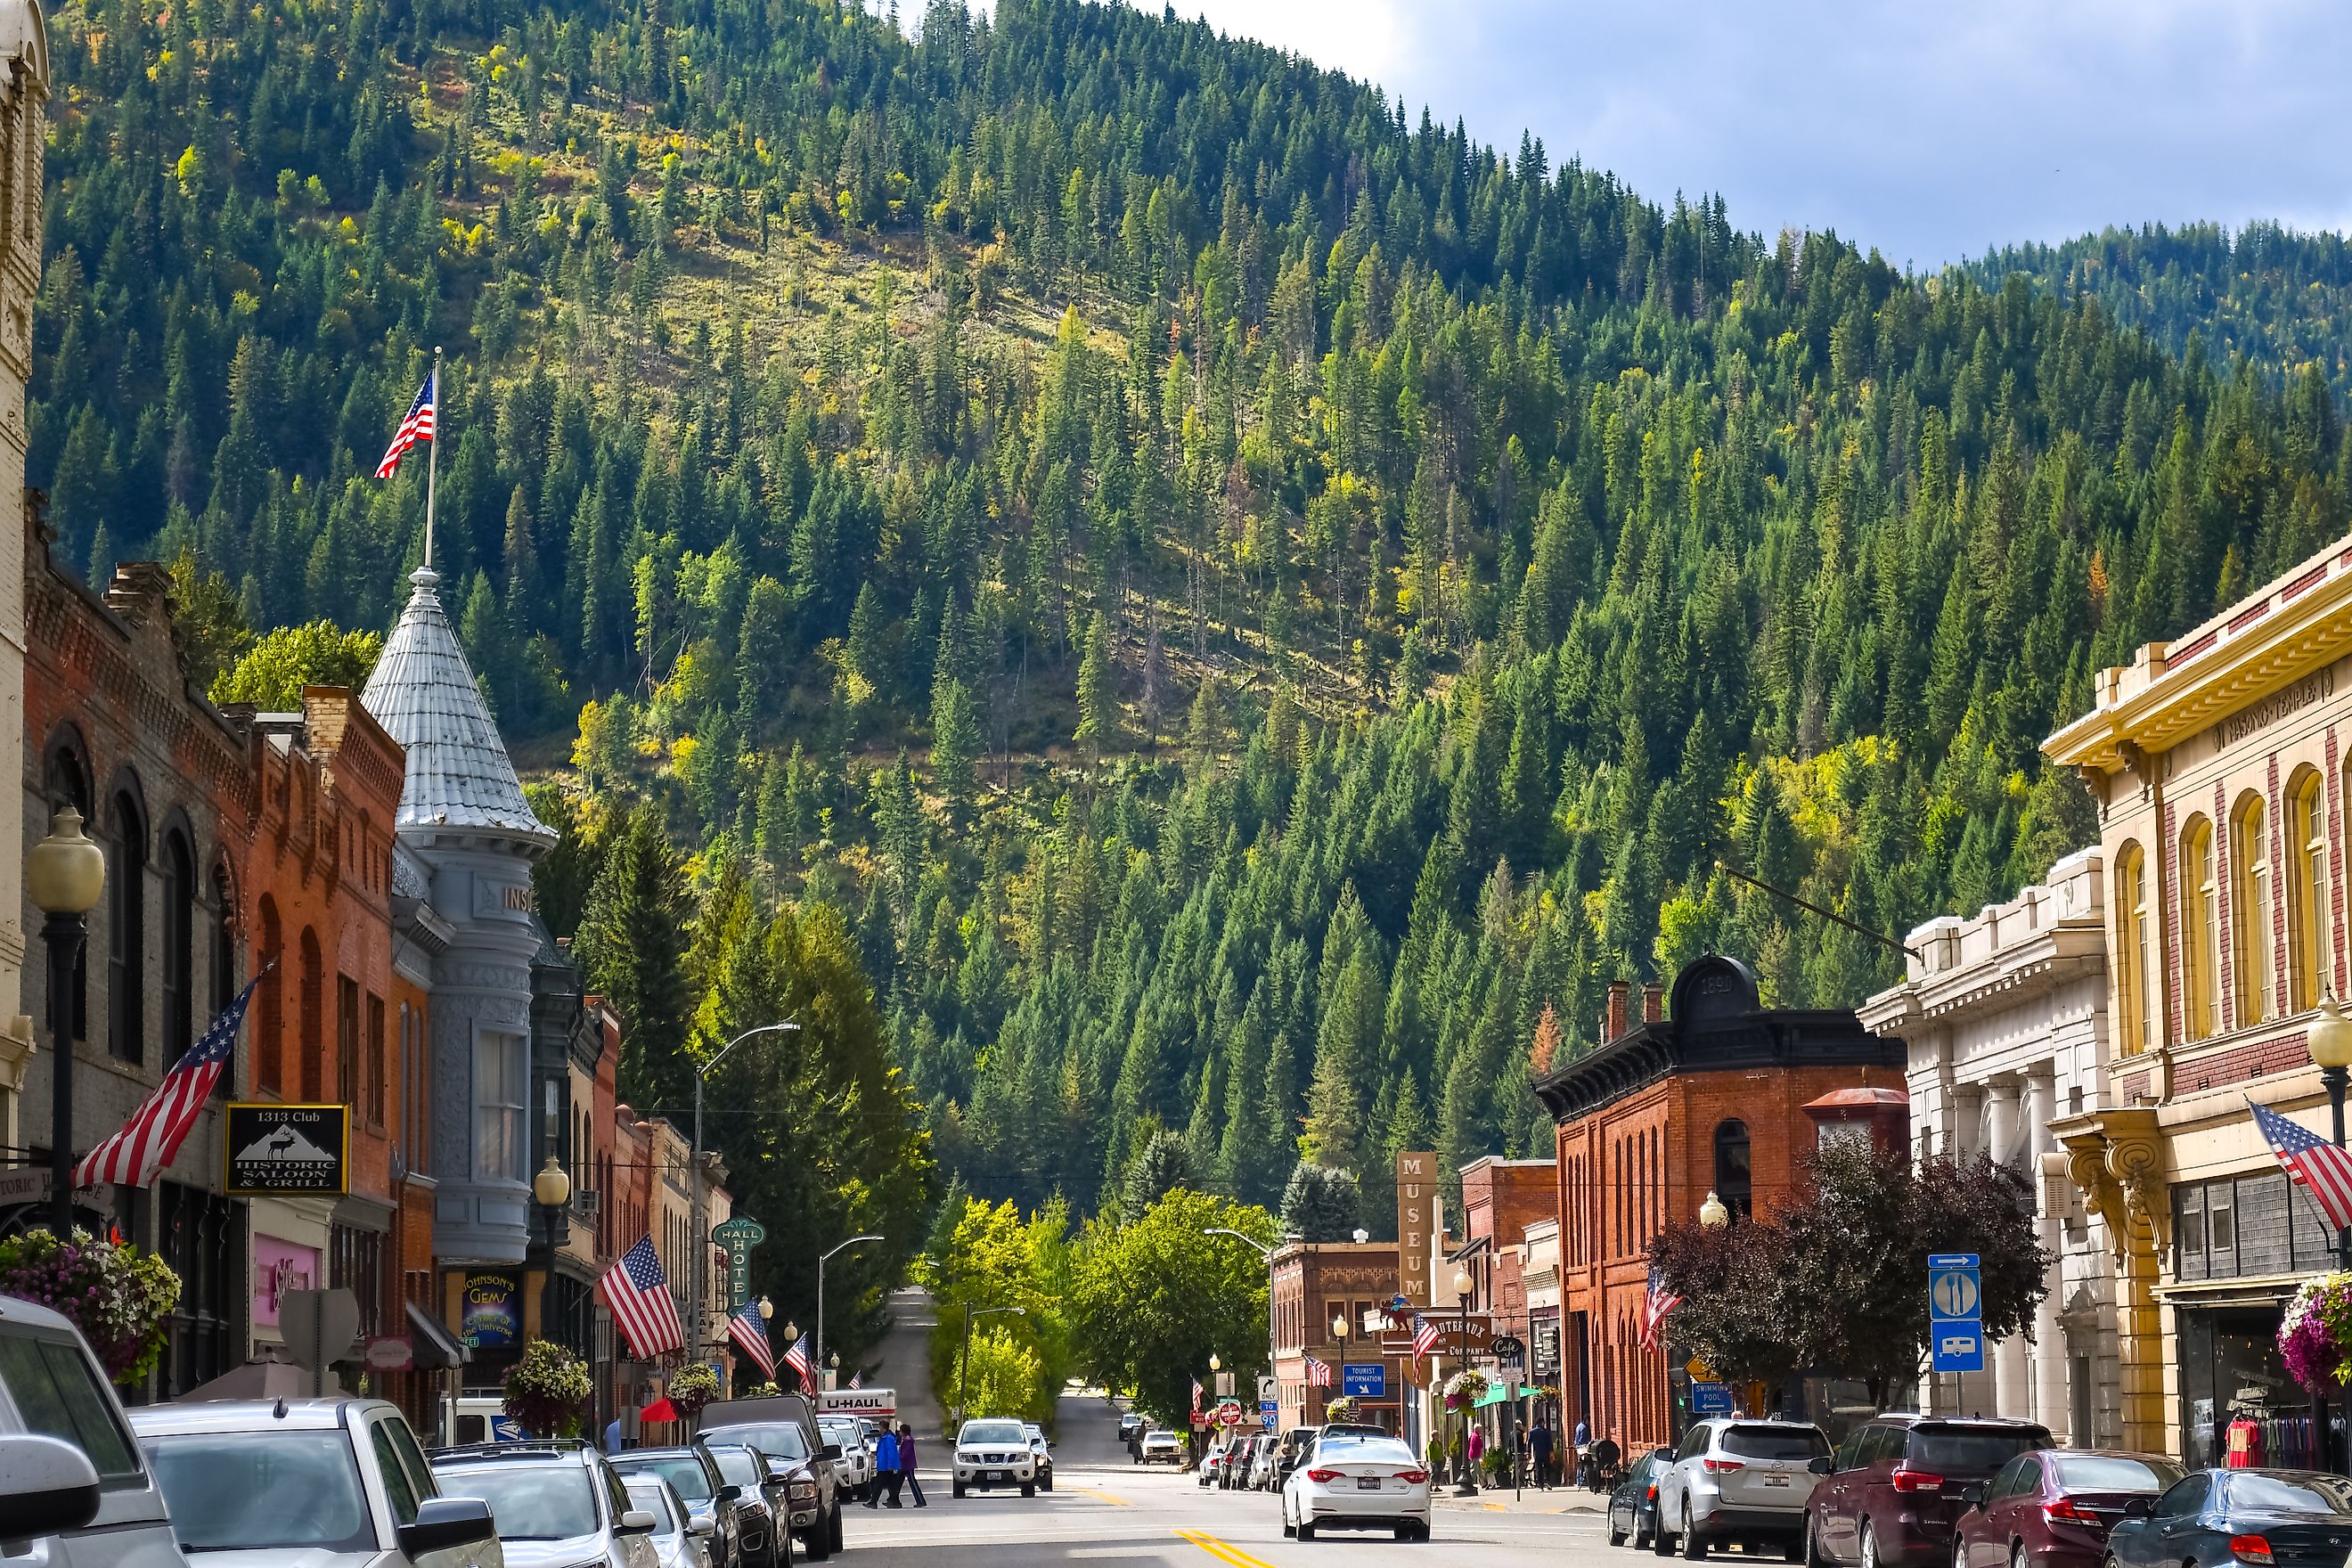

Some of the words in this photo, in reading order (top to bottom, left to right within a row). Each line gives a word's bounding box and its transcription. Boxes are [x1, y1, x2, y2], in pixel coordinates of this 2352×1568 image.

[2229, 706, 2269, 743] MASONIC
[2274, 684, 2315, 720] TEMPLE
[257, 1112, 289, 1123] 1313
[292, 1112, 320, 1123] Club
[236, 1162, 336, 1170] HISTORIC
[242, 1171, 327, 1179] SALOON
[1402, 1159, 1425, 1295] MUSEUM
[733, 1240, 746, 1306] HOTEL
[463, 1276, 515, 1292] JOHNSON'S
[698, 1302, 706, 1335] REAL
[463, 1327, 477, 1337] the
[479, 1322, 512, 1338] Universe
[1695, 1384, 1727, 1392] SWIMMIN
[1703, 1393, 1721, 1401] POOL
[827, 1399, 883, 1409] U-HAUL
[1262, 1415, 1276, 1425] 90
